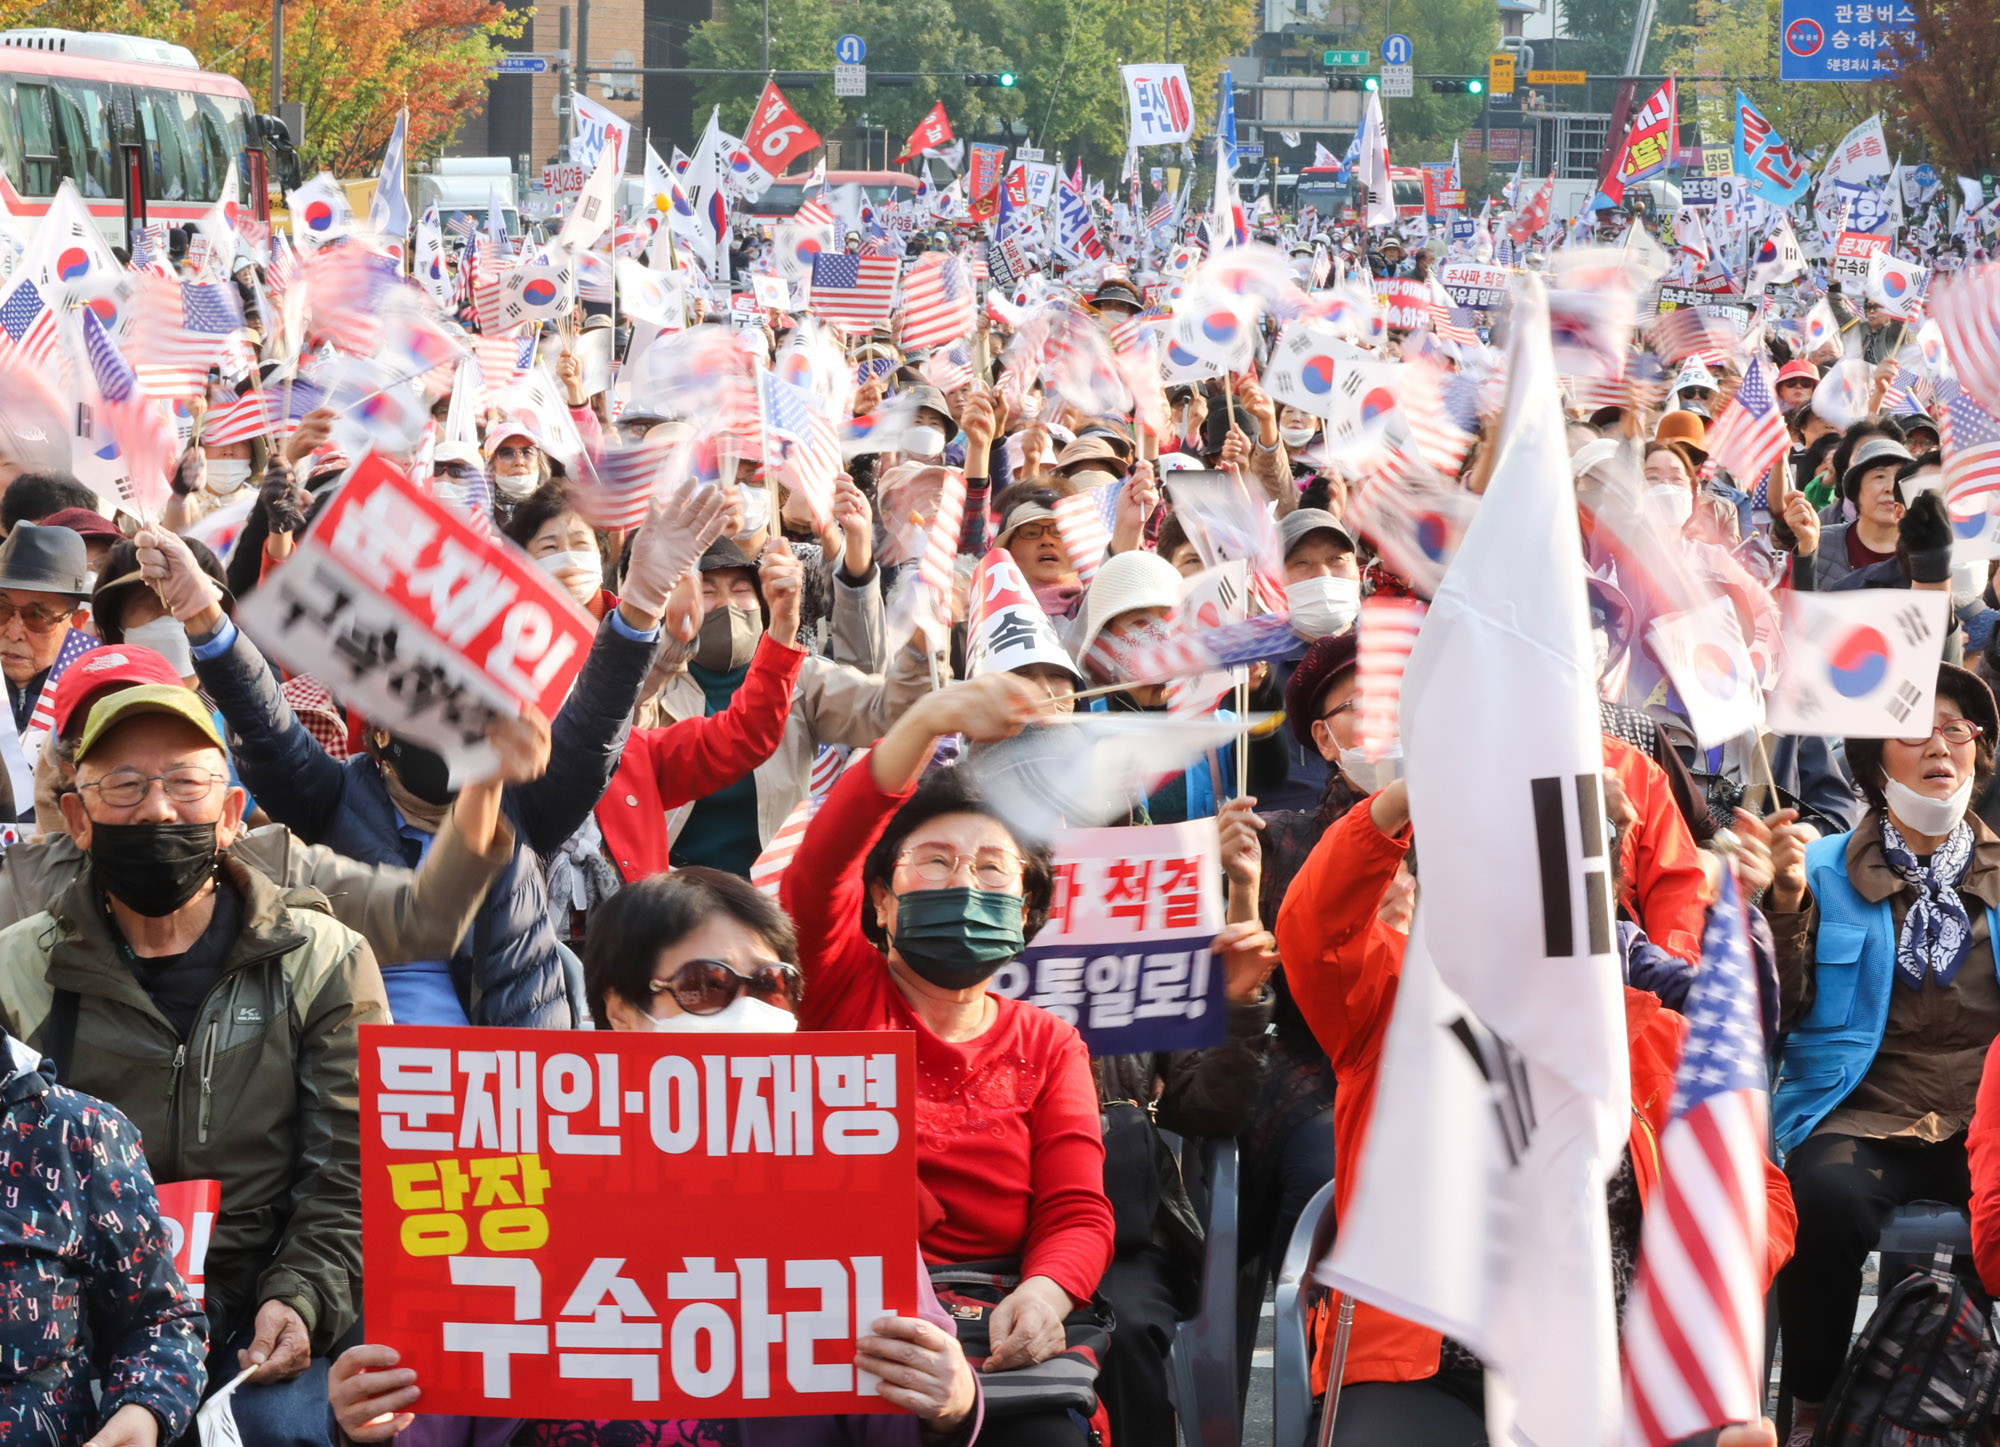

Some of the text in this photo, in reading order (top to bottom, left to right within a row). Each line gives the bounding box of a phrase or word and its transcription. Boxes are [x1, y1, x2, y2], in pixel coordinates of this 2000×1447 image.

[1835, 4, 1915, 24] 관광버스
[1332, 53, 1360, 63] 시청
[1826, 58, 1869, 72] 5분경과시
[1161, 75, 1189, 133] 10
[762, 124, 804, 156] 6
[562, 166, 583, 191] 23호
[1682, 178, 1717, 200] 포항
[1720, 181, 1733, 200] 9
[1246, 207, 1255, 220] 7
[1454, 223, 1473, 234] 포항
[1839, 237, 1887, 258] 문재인
[1446, 269, 1506, 288] 주사파 척결
[1103, 854, 1206, 932] 척결
[376, 1045, 900, 1157] 문재인·이재명
[386, 1153, 552, 1258] 당장
[442, 1255, 899, 1402] 구속하라
